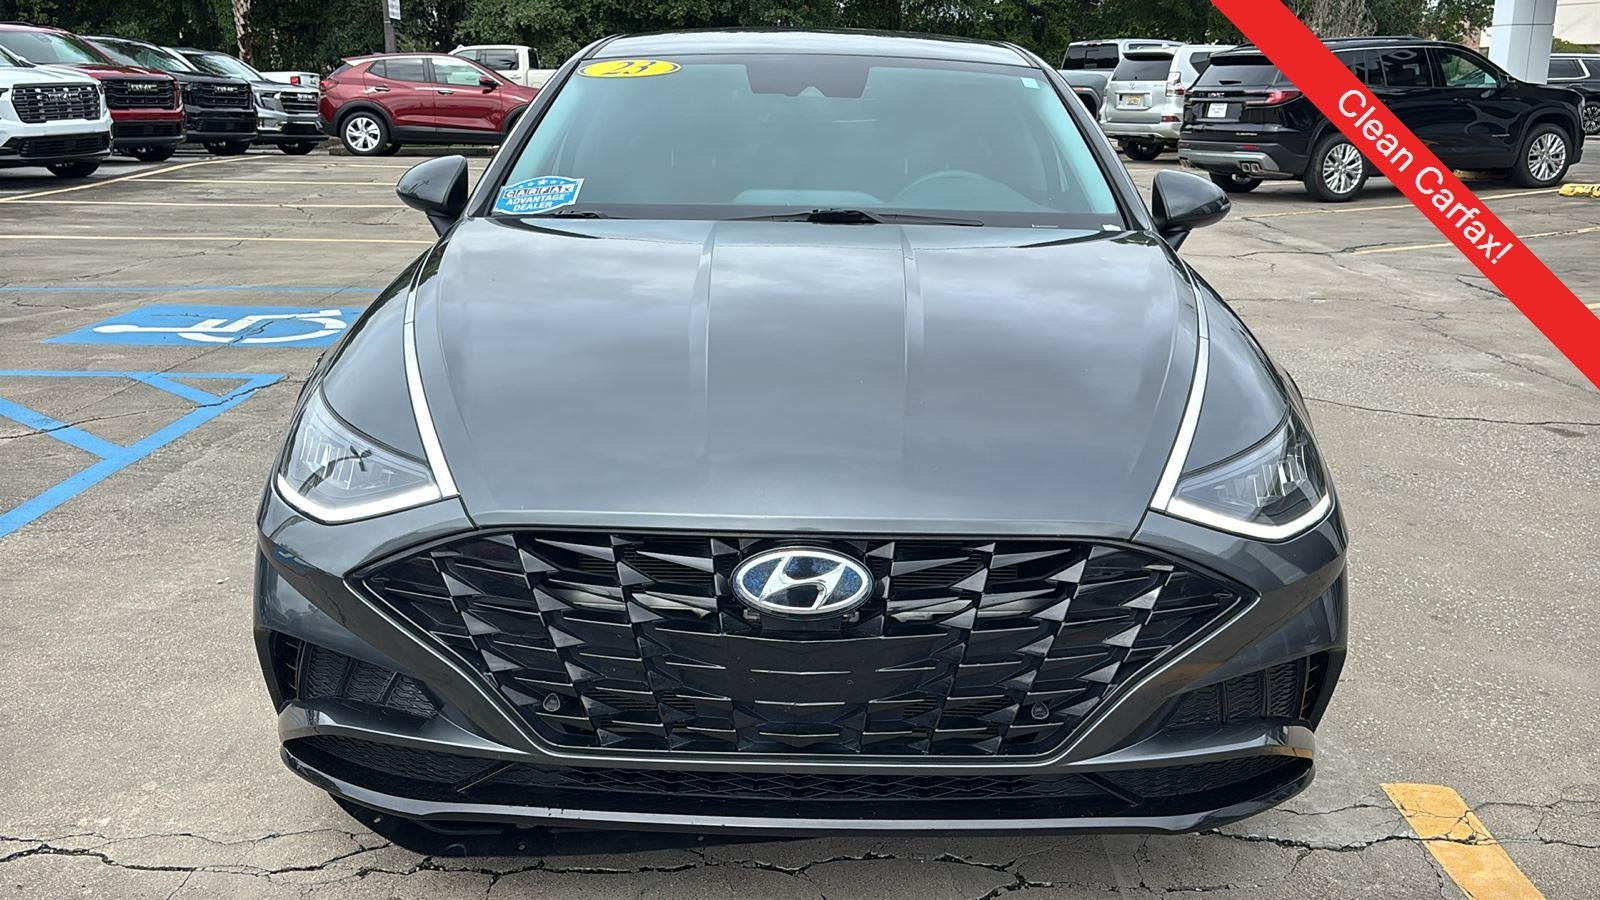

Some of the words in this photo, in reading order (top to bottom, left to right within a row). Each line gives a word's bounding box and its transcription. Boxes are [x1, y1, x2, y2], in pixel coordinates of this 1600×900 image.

[600, 61, 656, 75] 23
[504, 184, 575, 198] CARFAX
[506, 194, 566, 206] ADVANTAGE
[512, 201, 553, 211] DEALER
